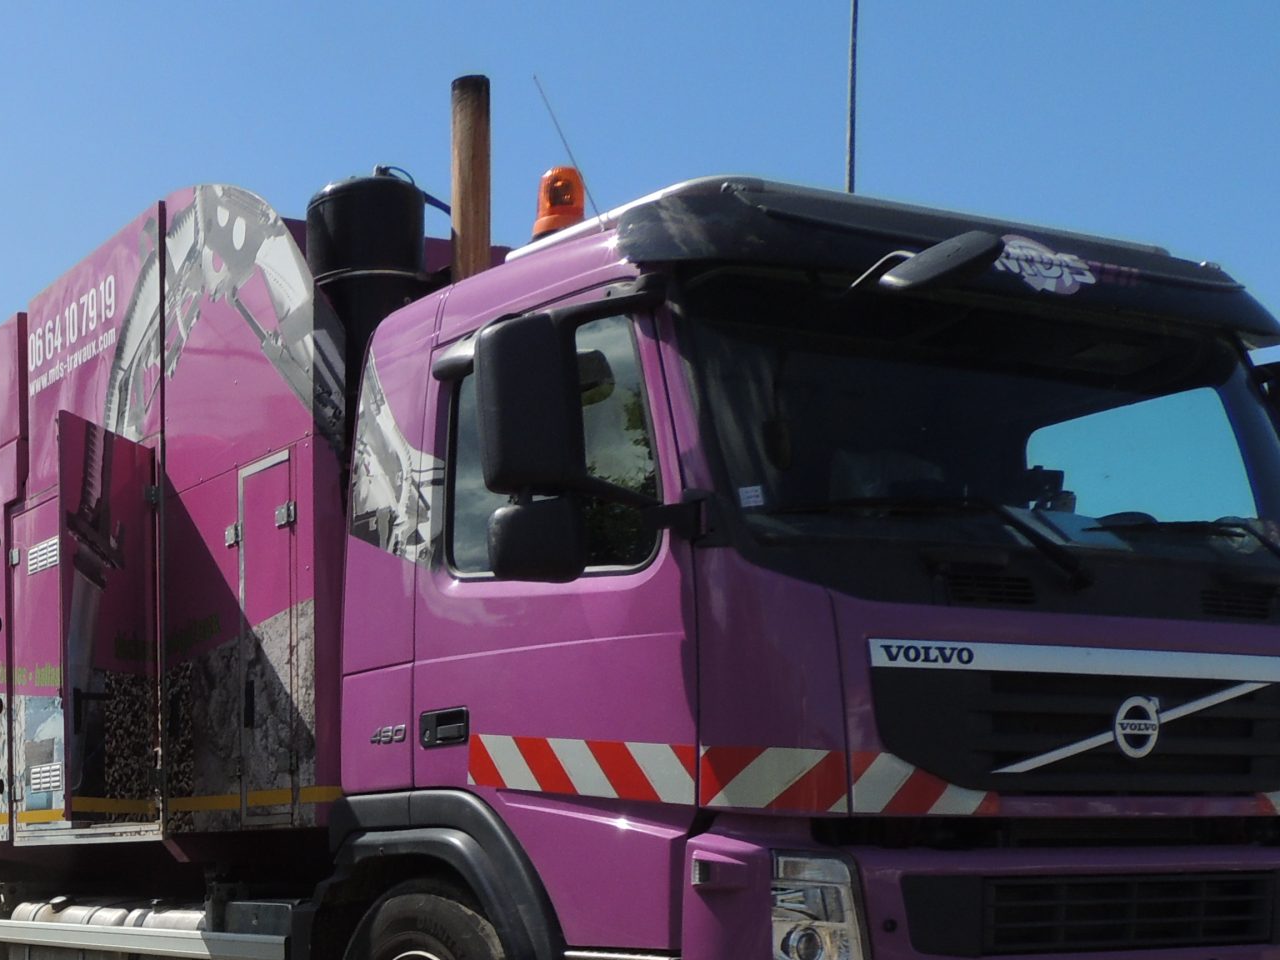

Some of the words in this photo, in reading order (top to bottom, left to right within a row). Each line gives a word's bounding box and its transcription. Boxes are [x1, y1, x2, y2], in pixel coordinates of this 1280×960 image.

[28, 327, 44, 372] 06
[45, 314, 62, 360] 64
[64, 301, 78, 348] 10
[79, 287, 97, 337] 79
[99, 274, 116, 323] 19
[28, 327, 116, 397] www.mds-travaux.com
[879, 644, 975, 665] VOLVO
[1118, 722, 1158, 732] VOLVO
